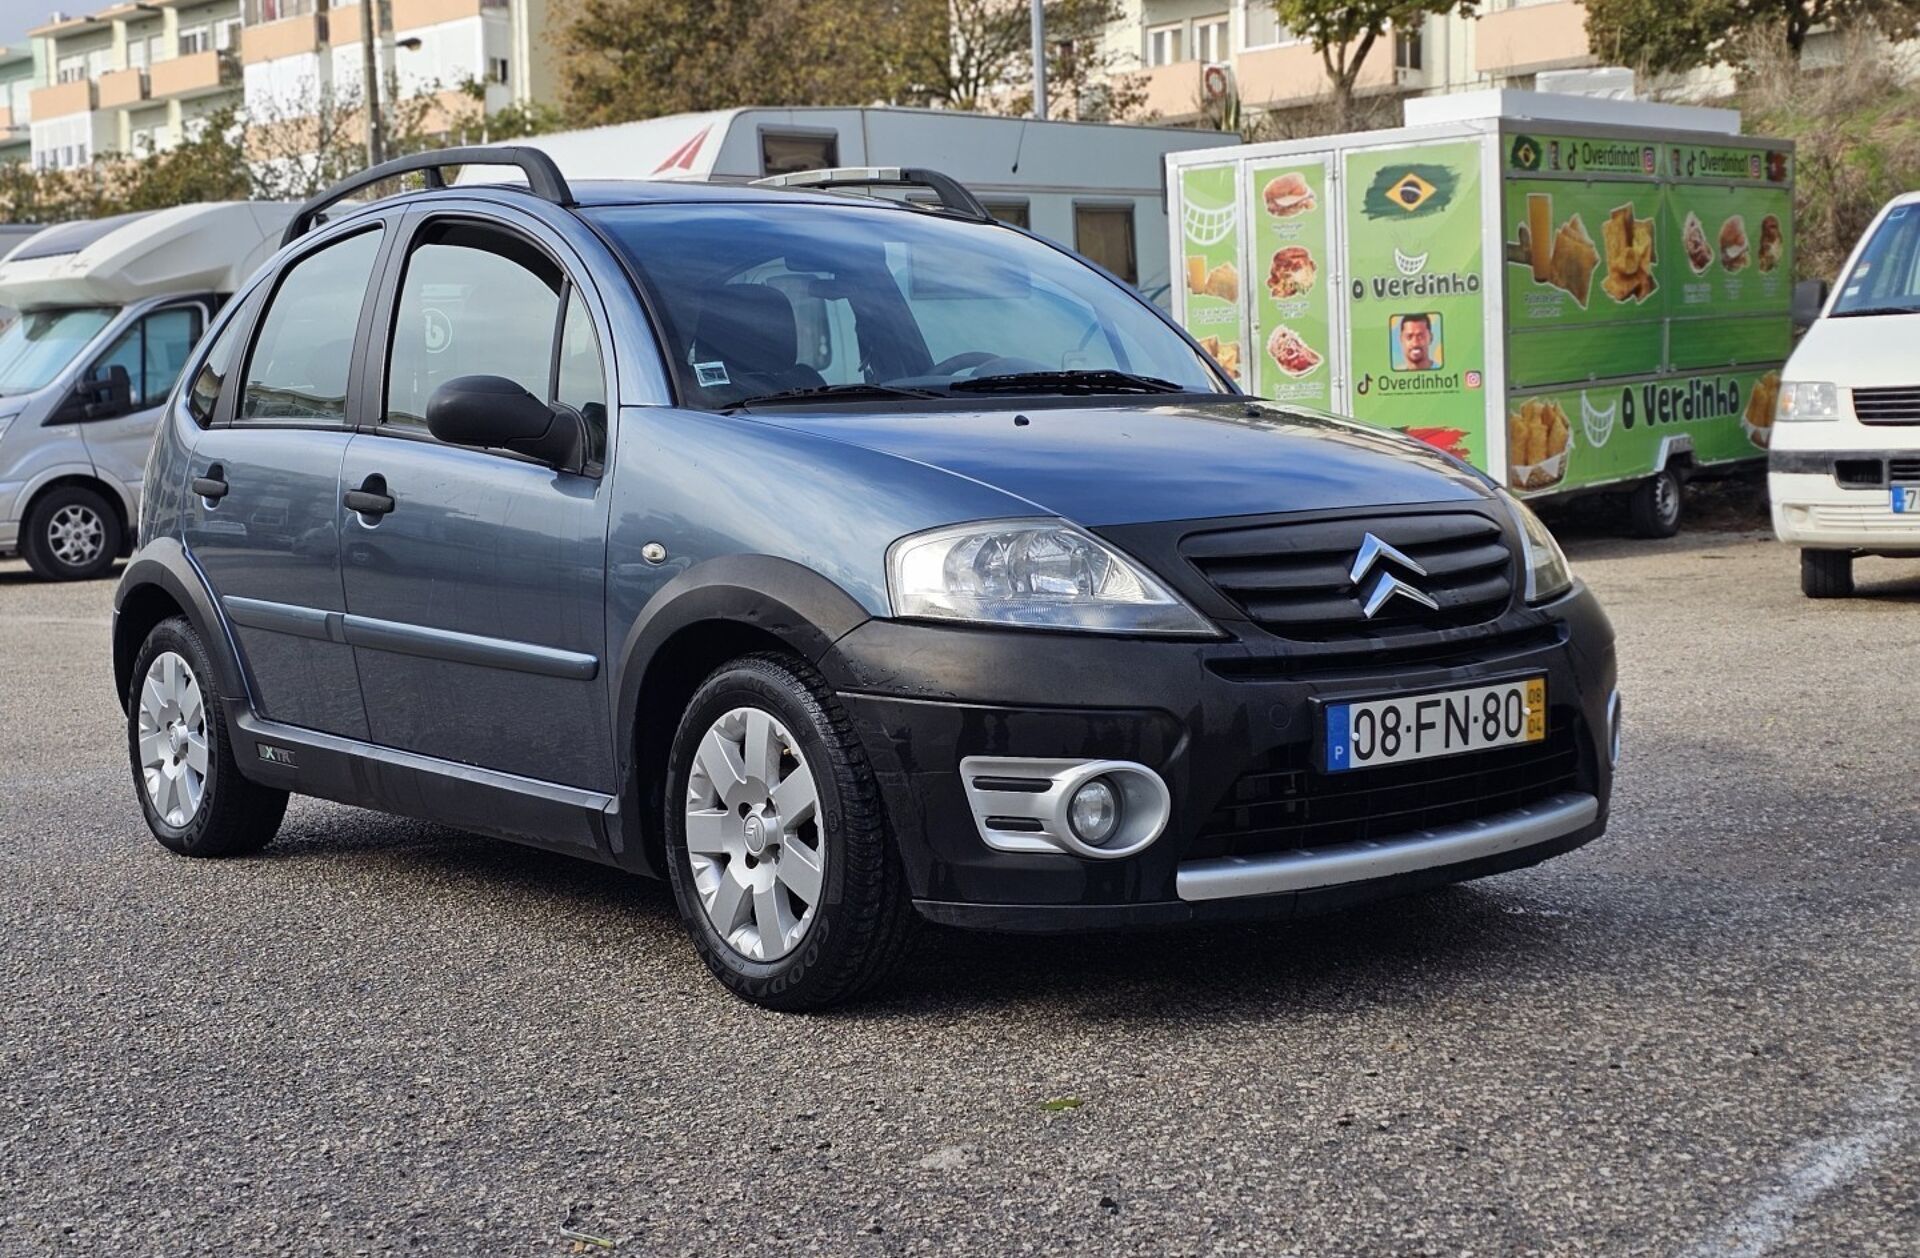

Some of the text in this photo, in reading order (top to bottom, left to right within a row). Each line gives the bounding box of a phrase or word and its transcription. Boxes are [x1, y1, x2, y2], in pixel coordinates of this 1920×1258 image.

[1373, 272, 1481, 299] Verdinho
[1377, 372, 1460, 392] Overdinho1
[1643, 377, 1741, 426] Verdinho
[1905, 490, 1920, 509] 7
[1527, 687, 1542, 705] 08
[1527, 717, 1542, 734] 04
[264, 745, 292, 764] XTR
[1334, 744, 1344, 761] P
